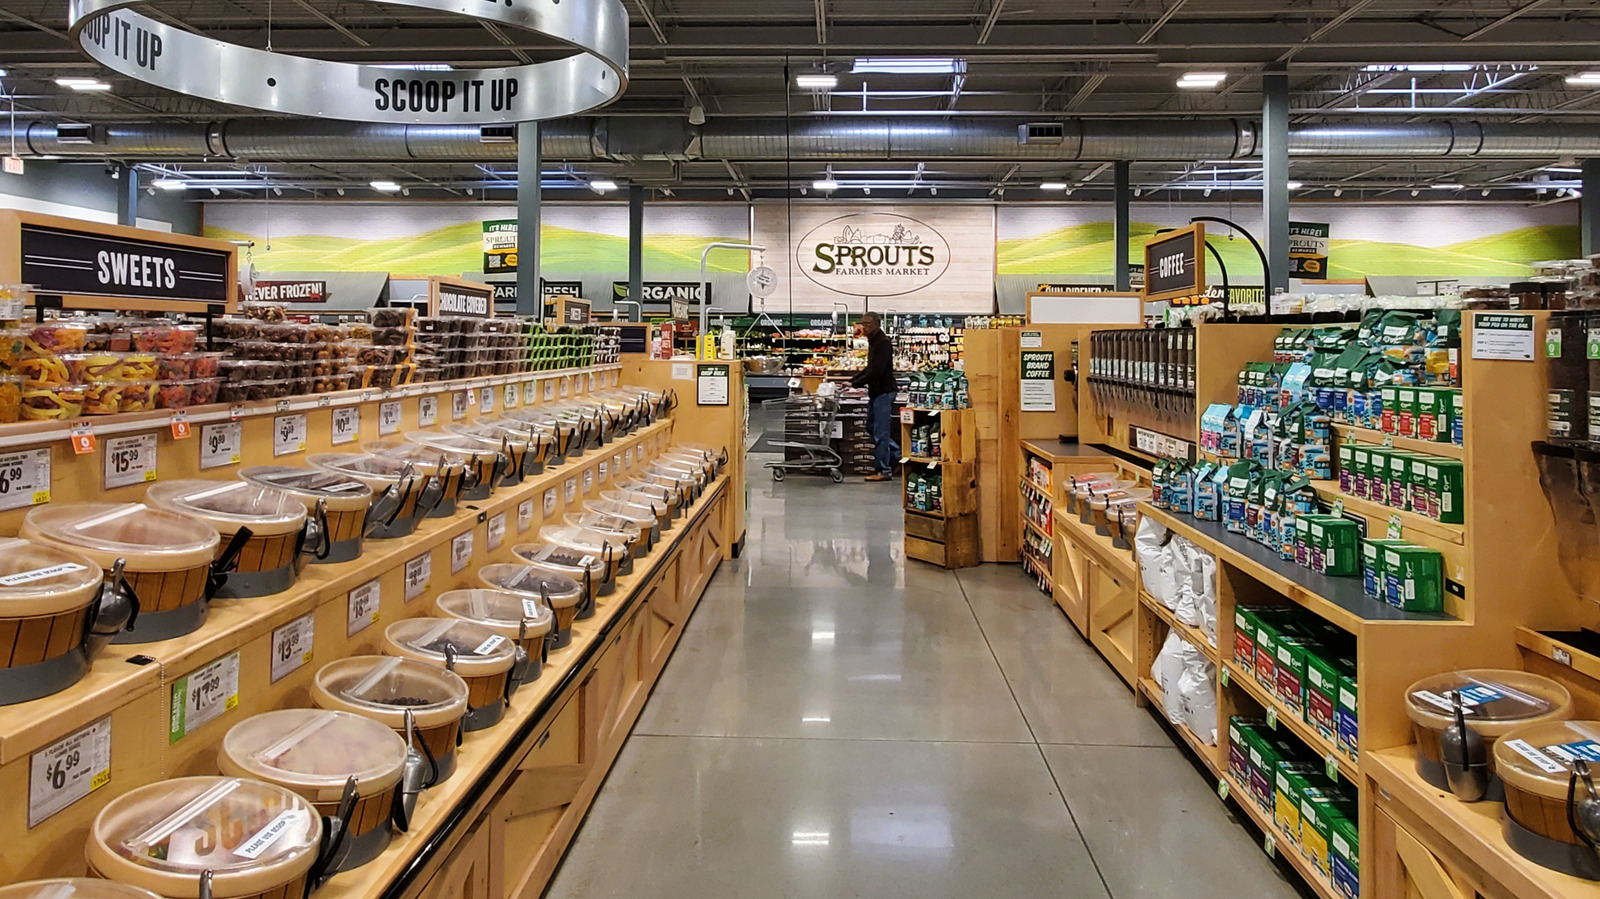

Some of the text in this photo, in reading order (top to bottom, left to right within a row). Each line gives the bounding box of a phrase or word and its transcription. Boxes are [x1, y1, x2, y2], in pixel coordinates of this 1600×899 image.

[115, 17, 131, 60] IT
[137, 27, 162, 71] UP
[375, 78, 518, 113] SCOOP IT UP
[98, 250, 176, 290] SWEETS
[835, 268, 931, 276] FARMERS MARKET
[1160, 252, 1184, 279] COFFEE
[280, 282, 323, 299] FROZEN!
[467, 296, 487, 315] COVERED
[1025, 370, 1050, 378] COFFEE
[245, 838, 266, 854] PLEASE
[261, 831, 274, 841] USE
